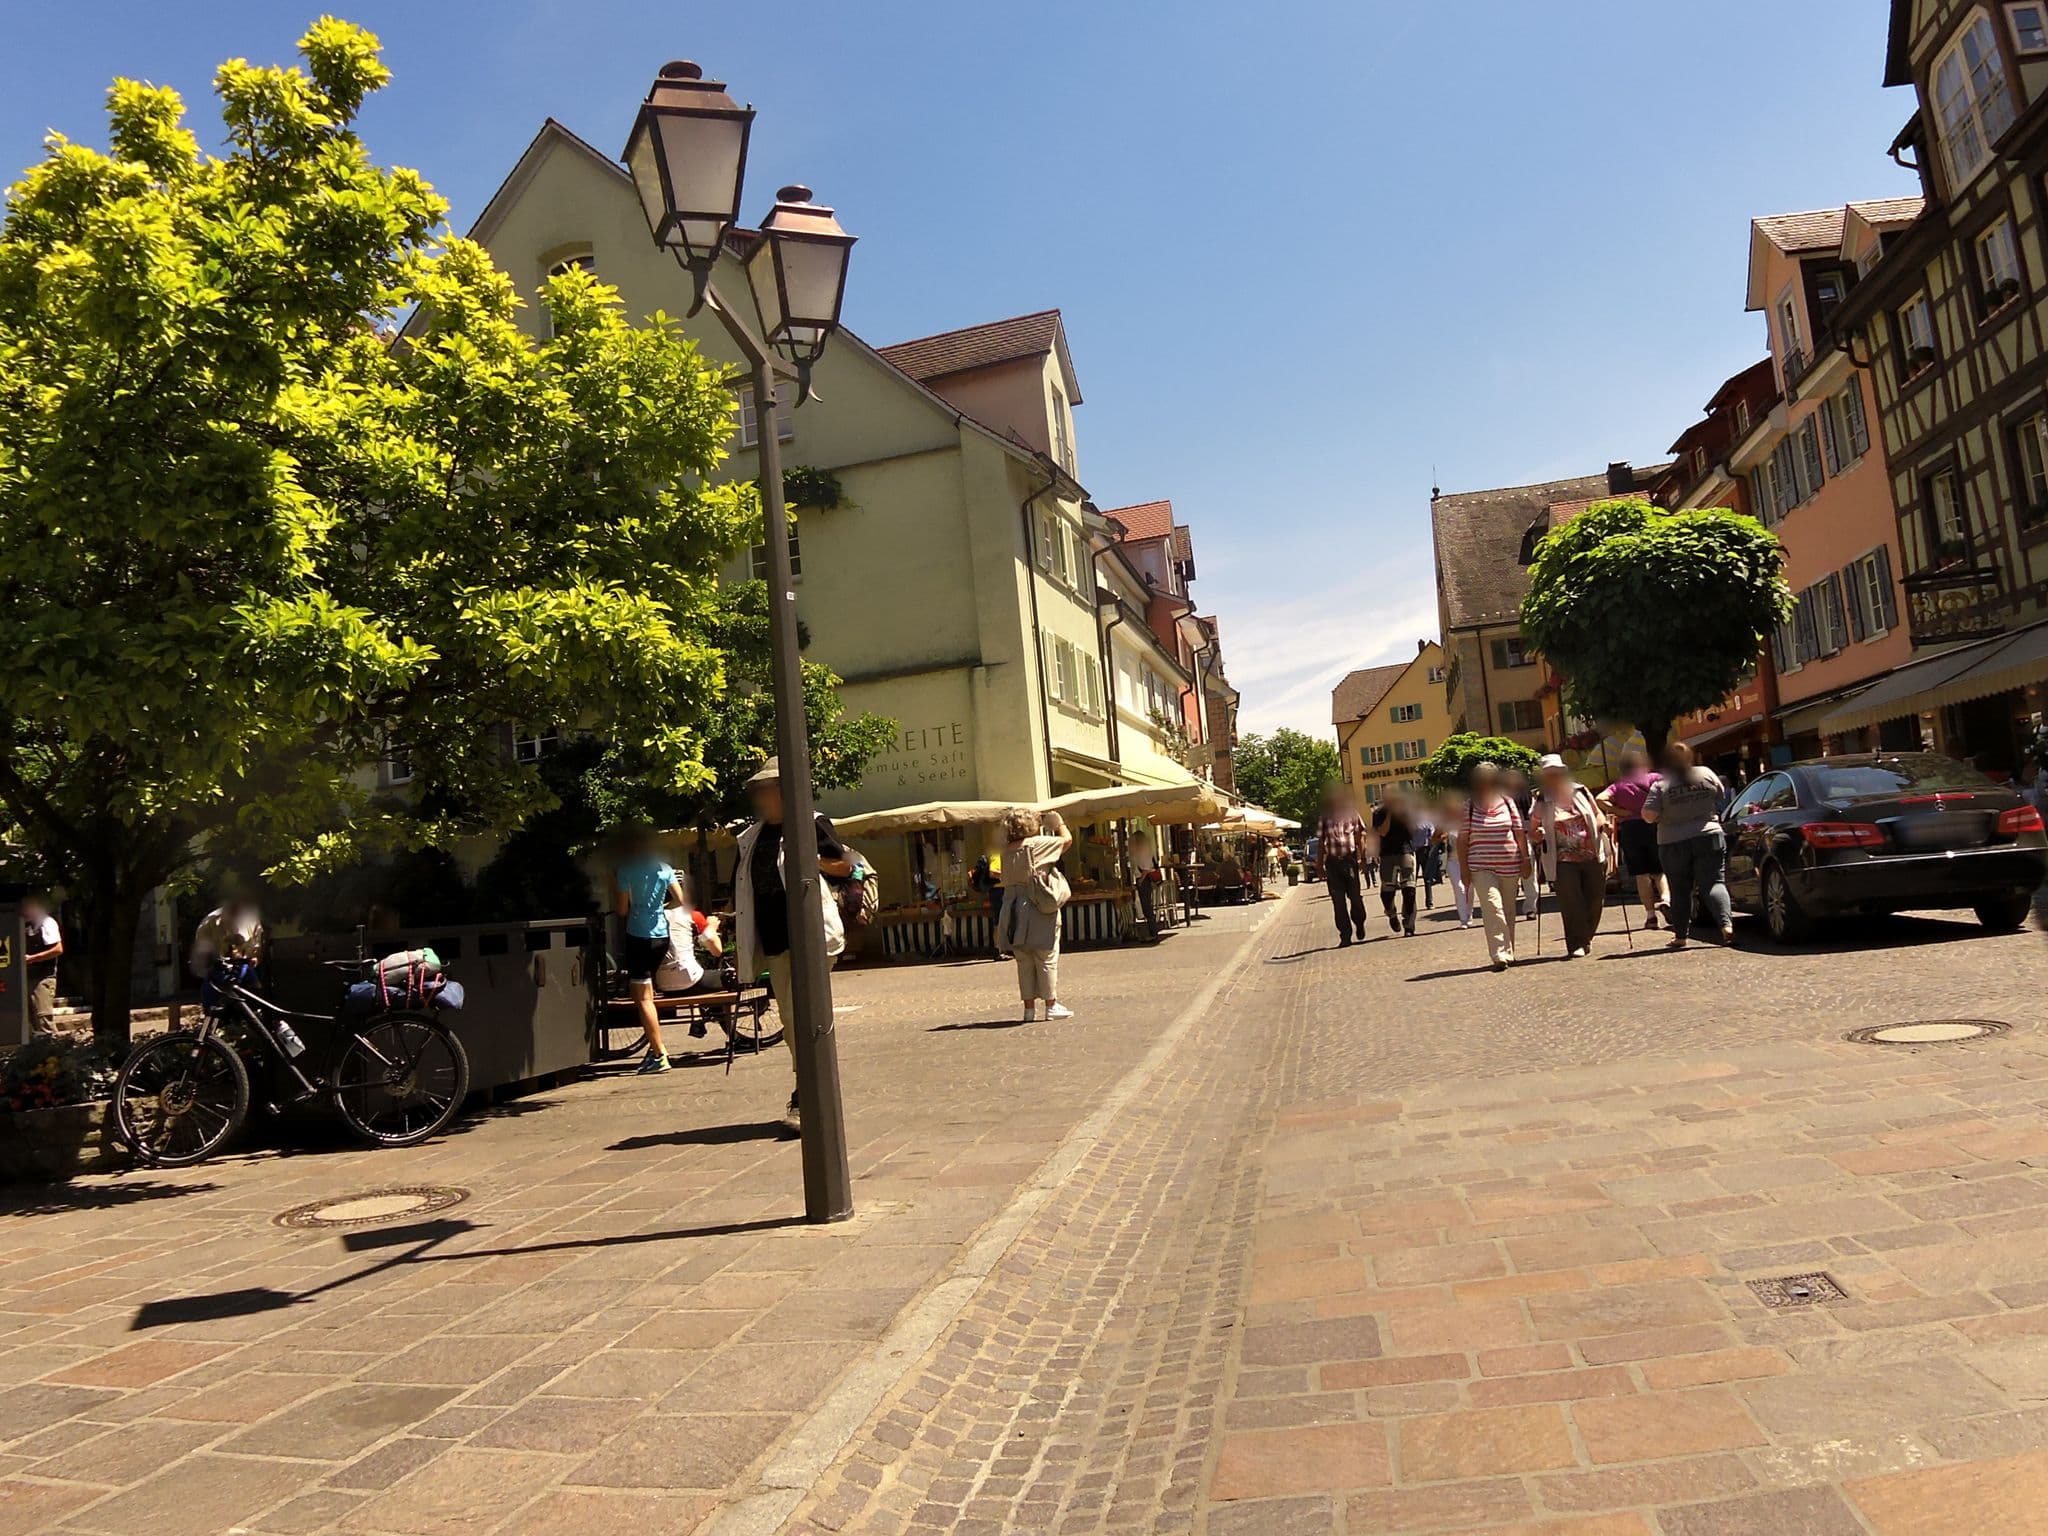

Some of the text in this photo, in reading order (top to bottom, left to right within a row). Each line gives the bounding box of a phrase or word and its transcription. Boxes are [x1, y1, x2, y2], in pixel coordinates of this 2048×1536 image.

[866, 759, 920, 776] emüse
[1362, 769, 1393, 781] HOTEL
[897, 767, 967, 786] & Seele
